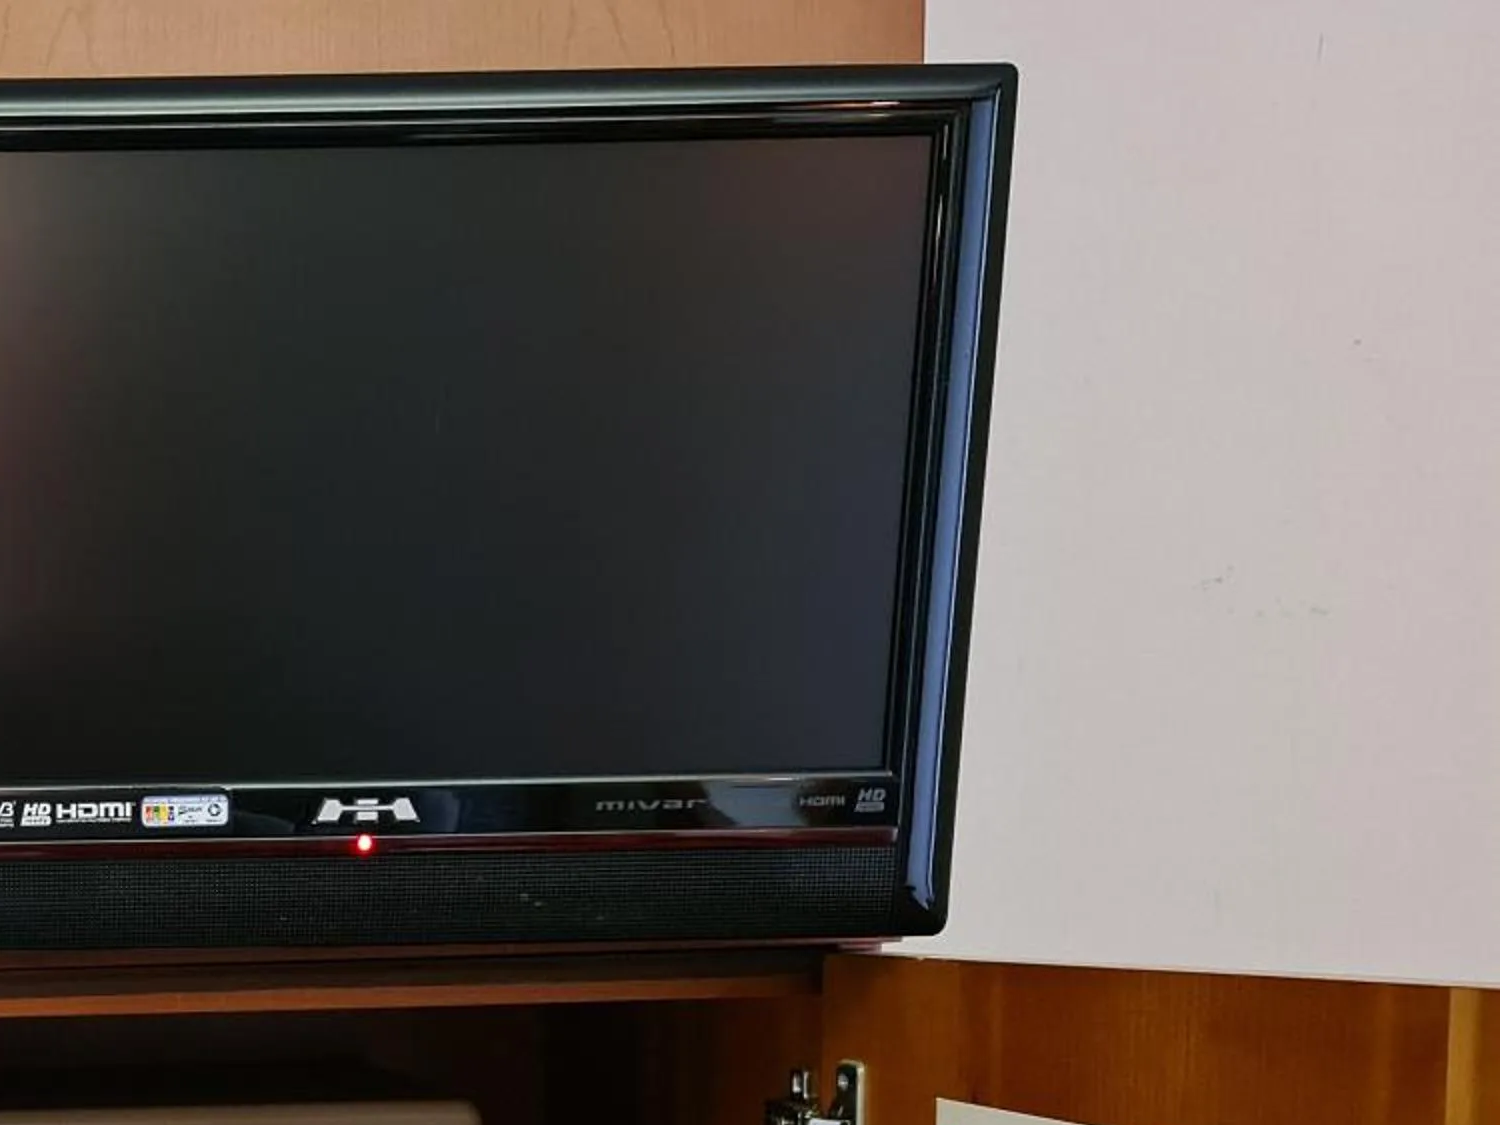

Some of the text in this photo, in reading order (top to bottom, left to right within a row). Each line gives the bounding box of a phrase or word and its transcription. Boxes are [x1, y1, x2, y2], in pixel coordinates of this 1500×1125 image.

[858, 788, 886, 801] HD
[24, 803, 51, 816] HD
[56, 802, 132, 818] HDMI
[595, 799, 707, 811] mivar
